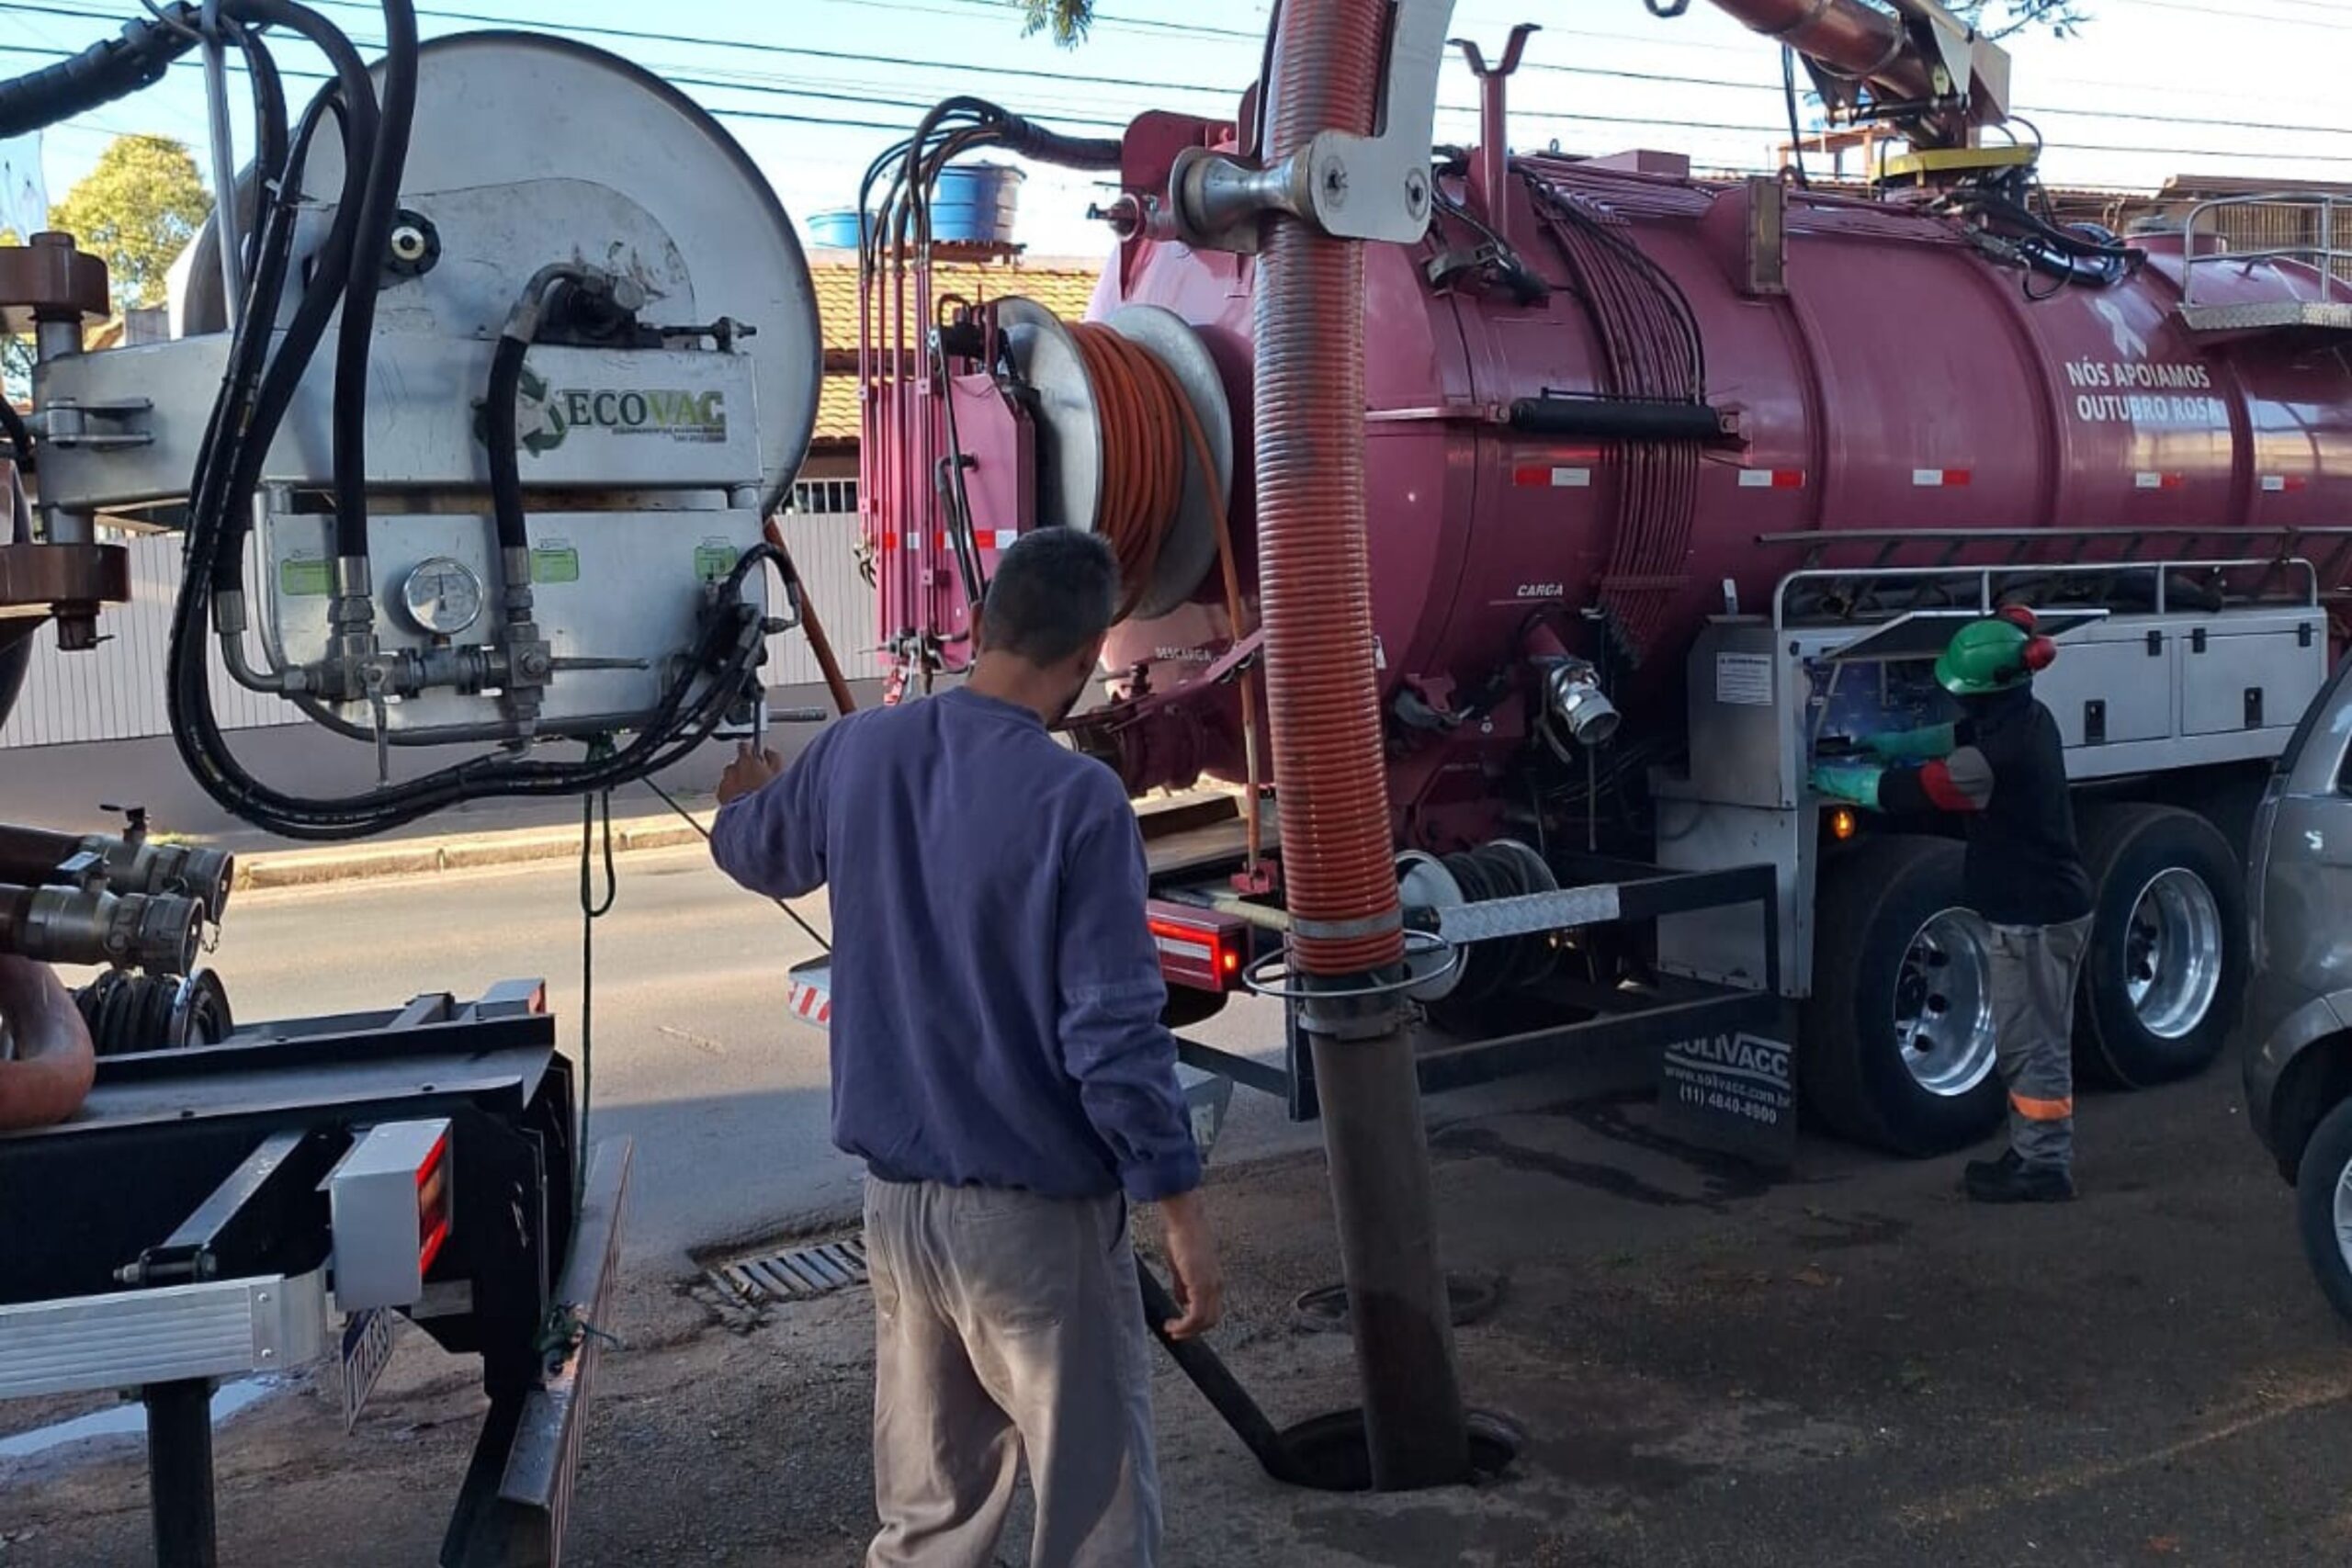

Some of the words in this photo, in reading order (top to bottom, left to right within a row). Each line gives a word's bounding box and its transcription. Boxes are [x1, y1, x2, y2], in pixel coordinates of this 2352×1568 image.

[2066, 355, 2109, 387] NÓS
[2114, 362, 2211, 389] APOIAMOS
[565, 389, 726, 426] ECOVAC
[2077, 395, 2167, 422] OUTUBRO
[1517, 583, 1563, 596] CARGA
[1679, 1081, 1704, 1106] (11)
